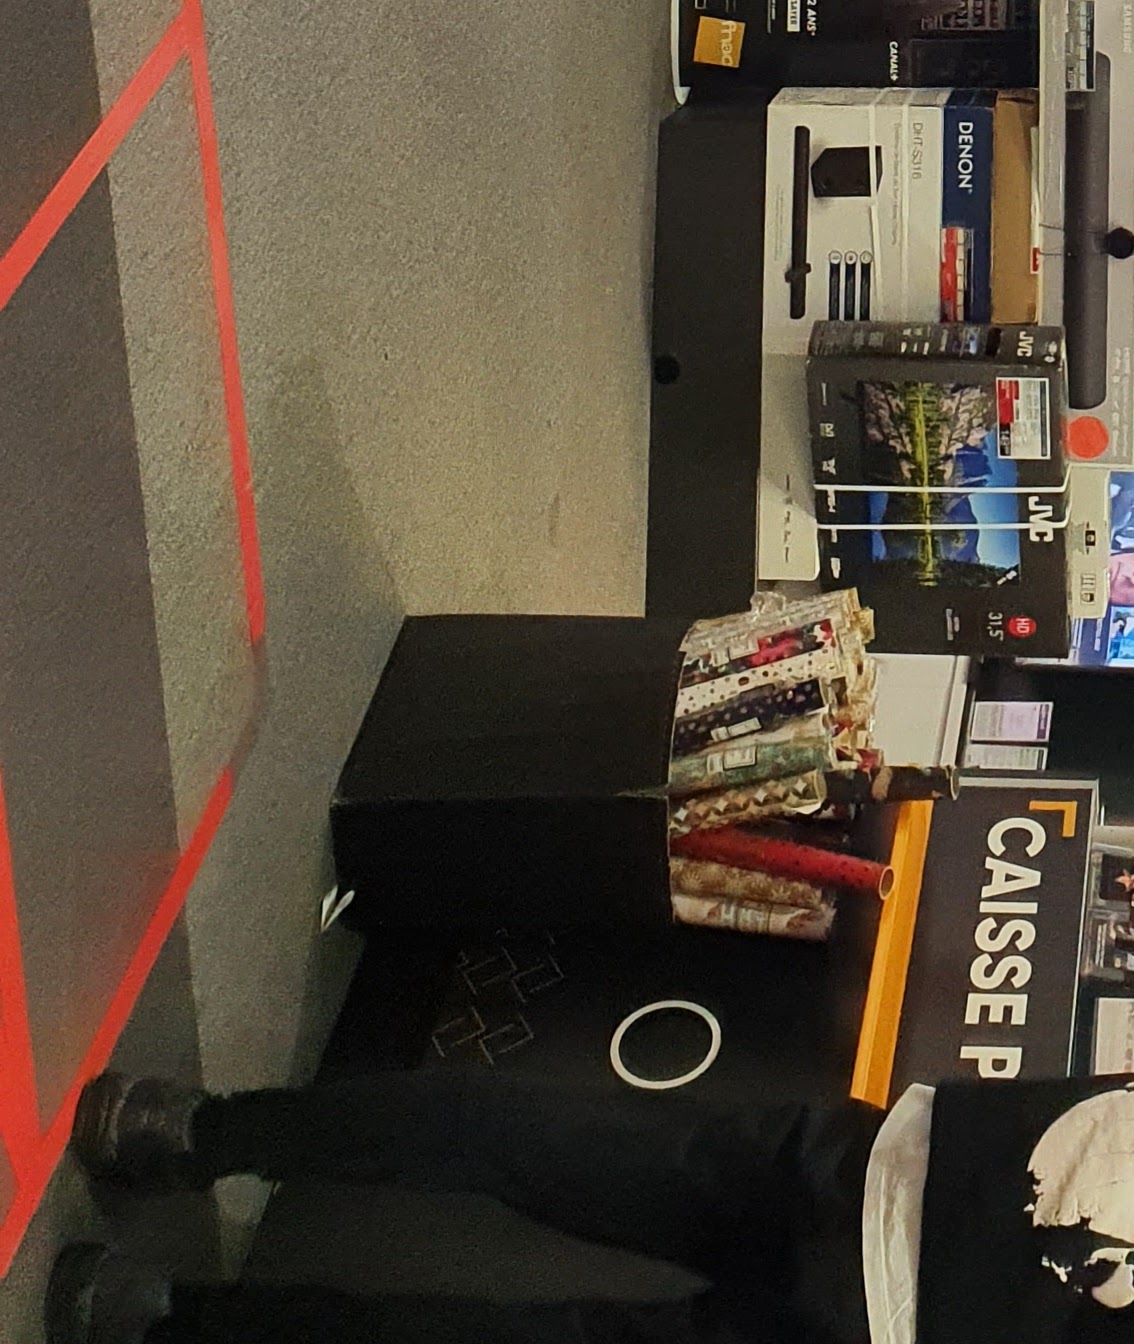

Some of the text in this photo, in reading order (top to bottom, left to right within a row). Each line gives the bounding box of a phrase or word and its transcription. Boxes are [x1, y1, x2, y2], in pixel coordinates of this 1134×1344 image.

[1123, 3, 1133, 54] SAMSUNG
[889, 41, 900, 82] CANAL+
[958, 121, 974, 189] DENON
[1016, 330, 1034, 358] JVC
[1028, 495, 1054, 543] JVC
[1016, 616, 1030, 634] HD
[959, 816, 1048, 1080] CAISSE P
